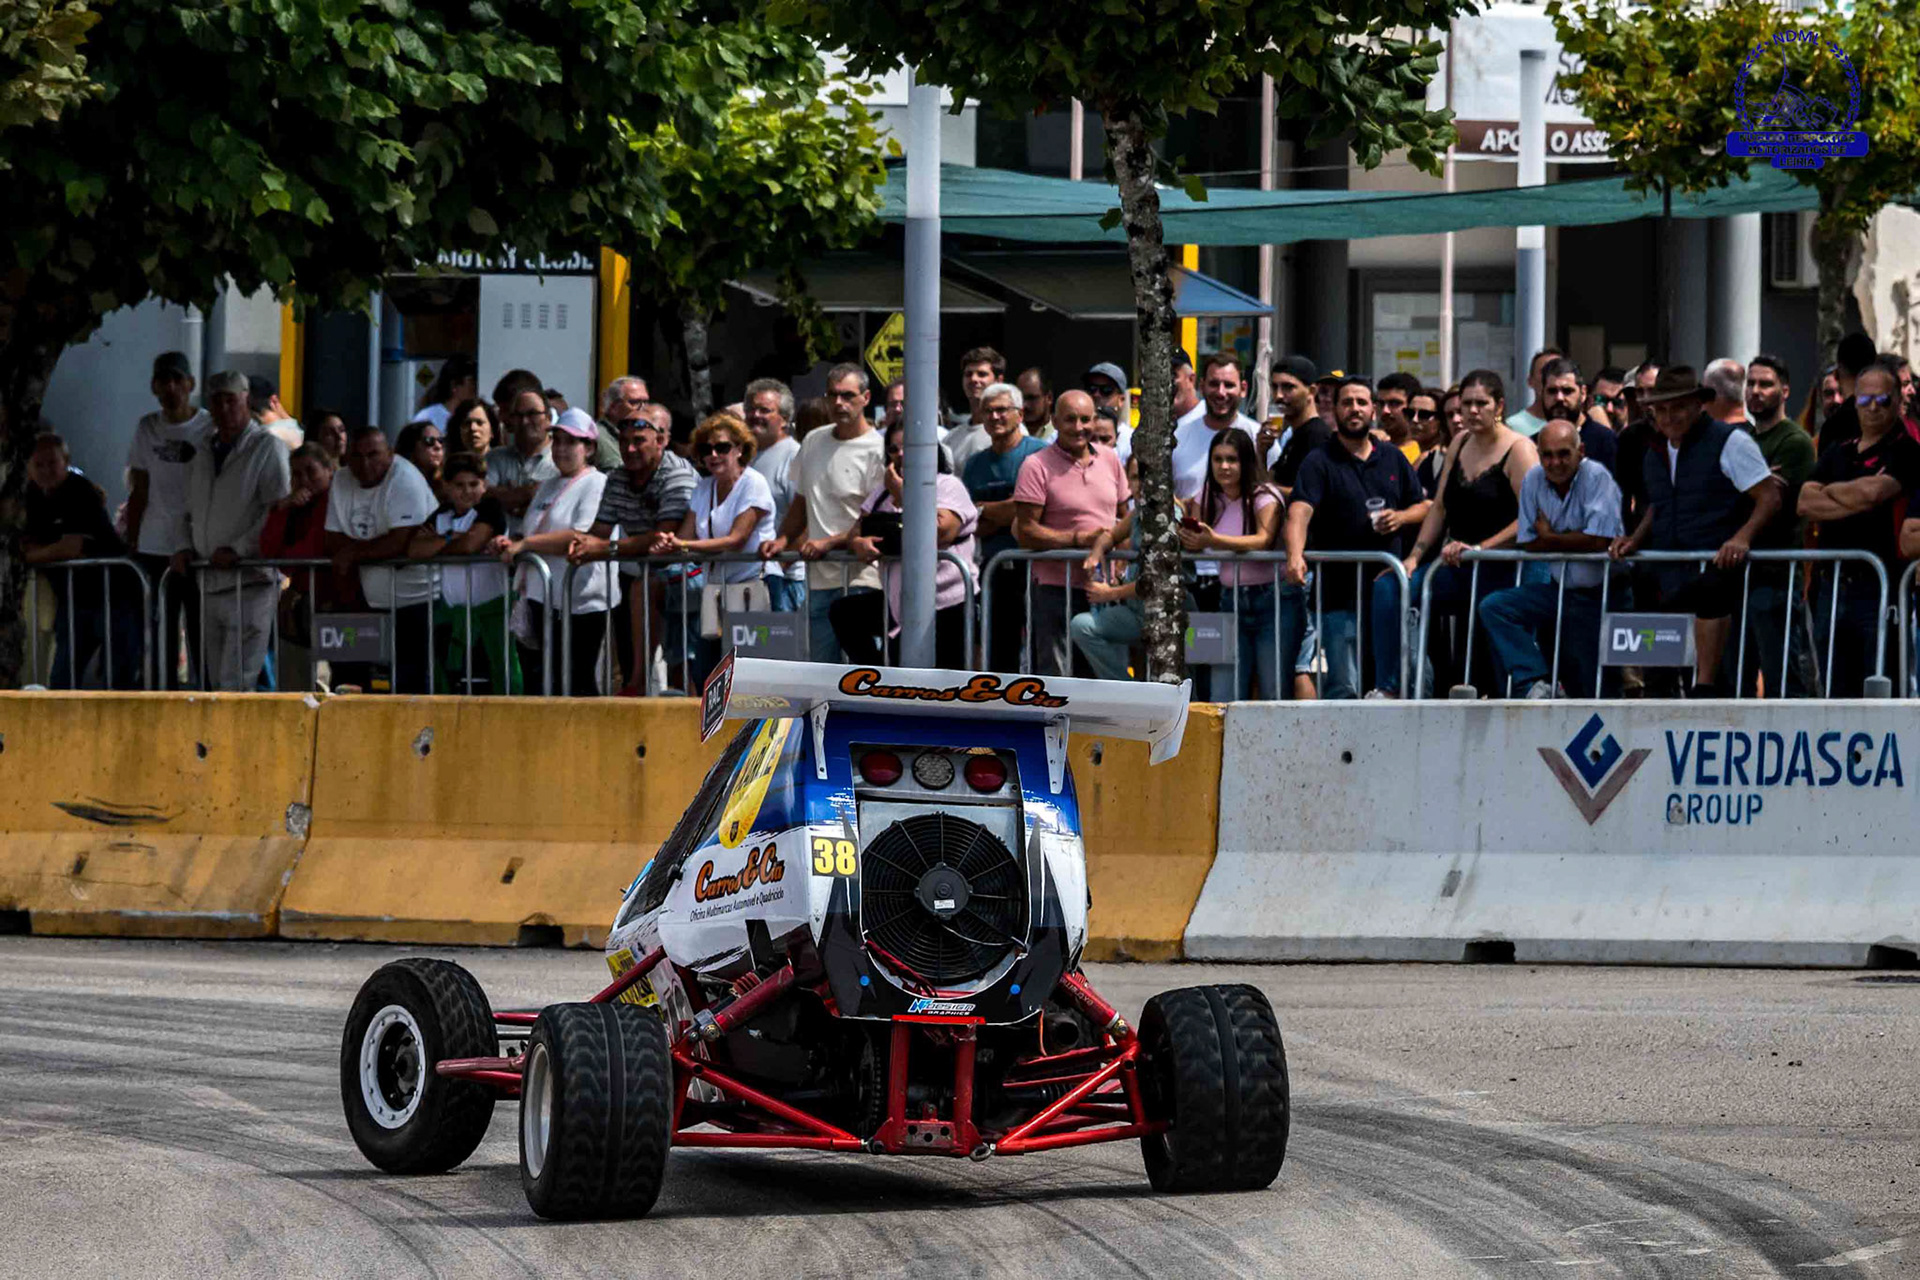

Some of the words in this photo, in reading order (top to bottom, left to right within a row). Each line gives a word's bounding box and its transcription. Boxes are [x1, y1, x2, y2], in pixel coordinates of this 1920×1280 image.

[1665, 731, 1904, 788] VERDASCA
[1666, 793, 1763, 826] GROUP
[813, 838, 857, 875] 38
